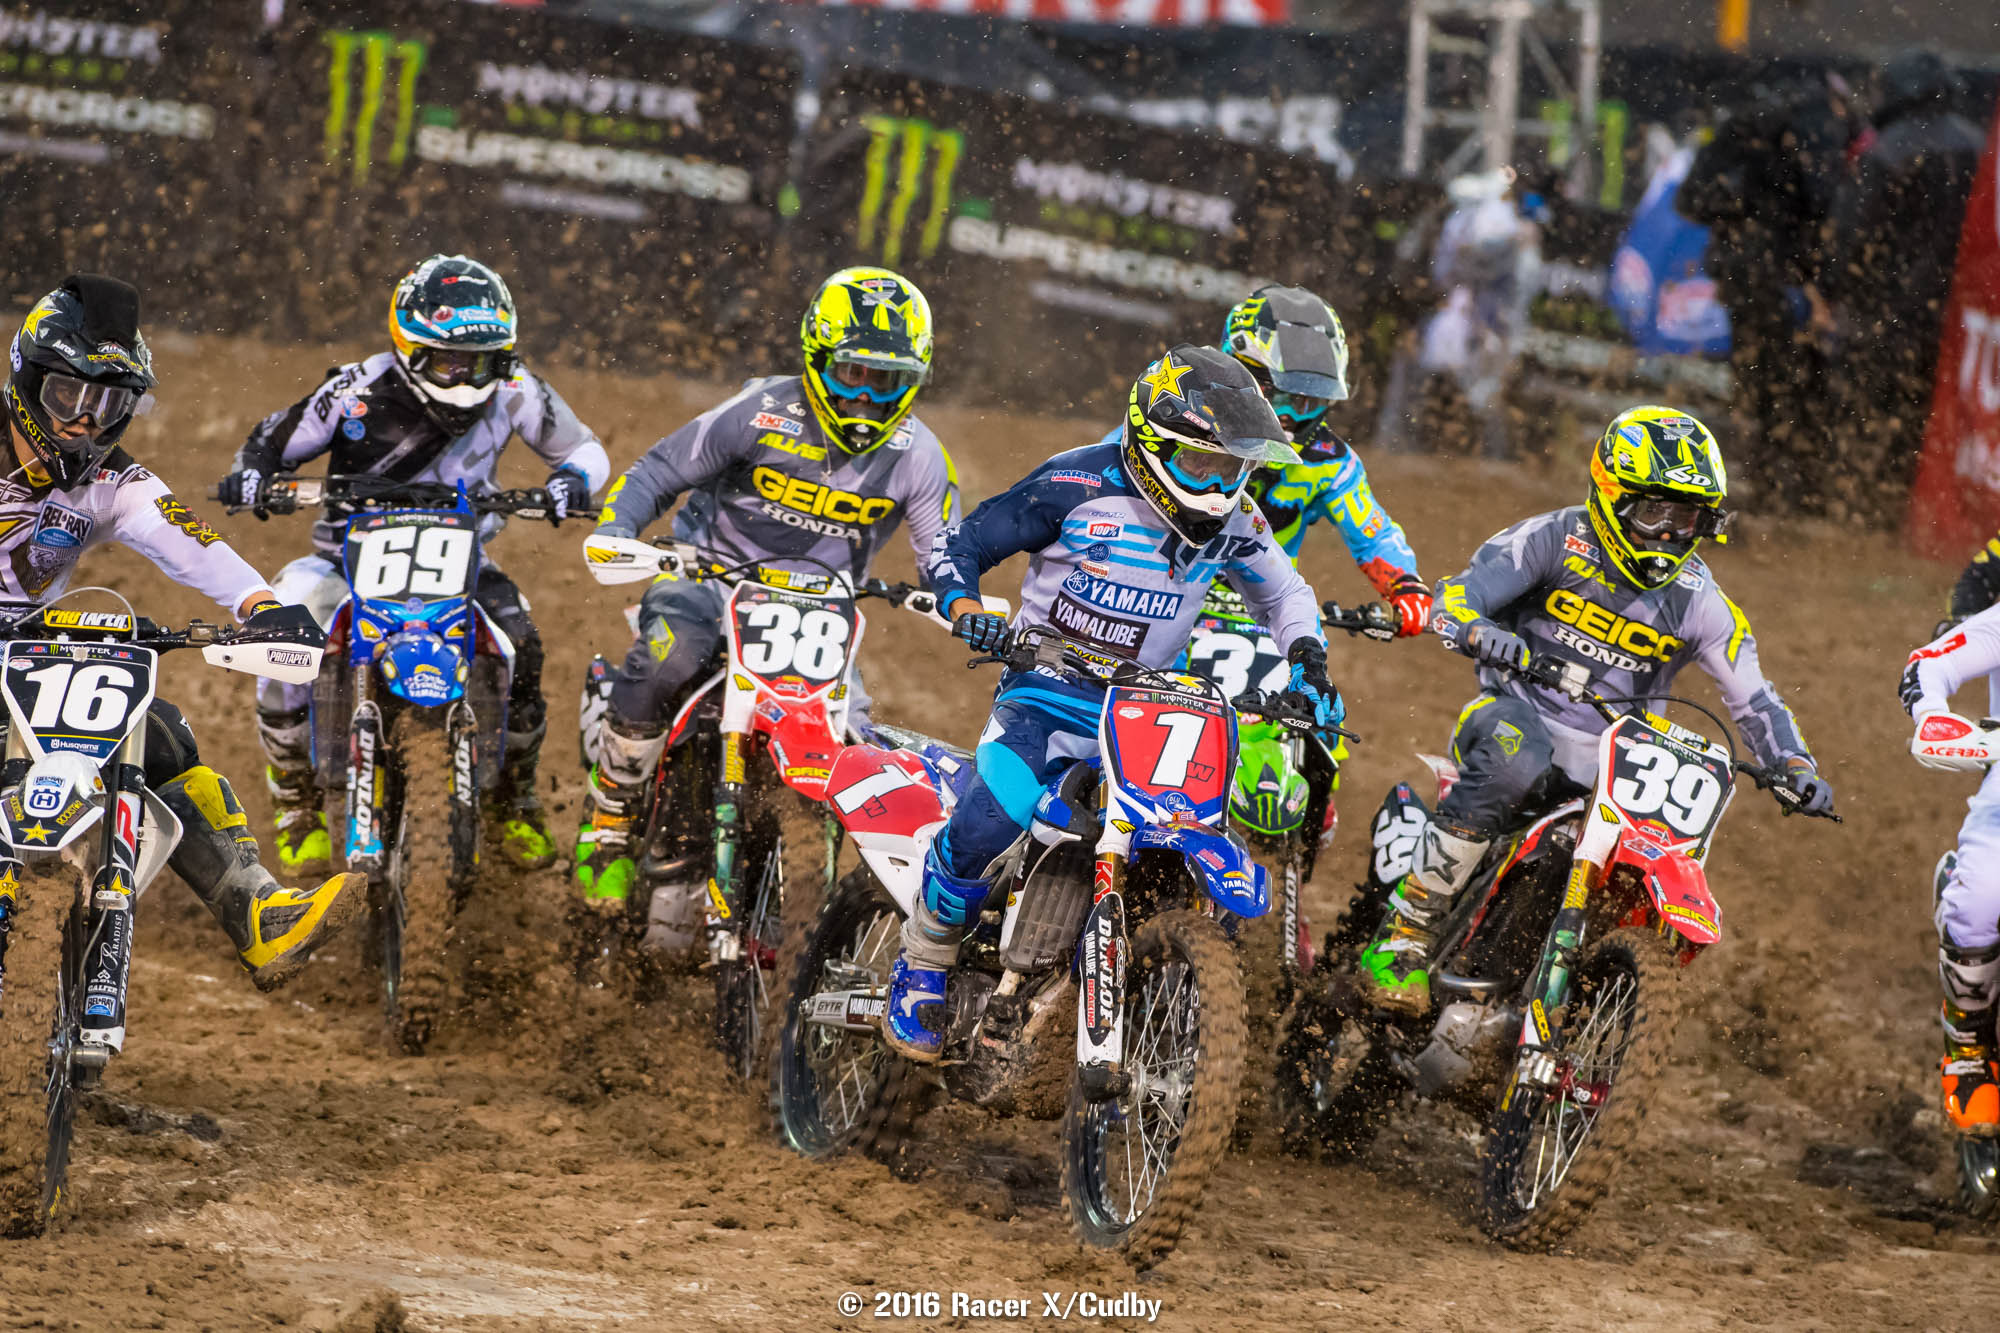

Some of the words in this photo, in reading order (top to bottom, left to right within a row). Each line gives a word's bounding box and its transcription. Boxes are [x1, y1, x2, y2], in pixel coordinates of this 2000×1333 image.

[752, 465, 897, 525] GEICO
[1664, 465, 1713, 487] 6D
[761, 503, 862, 540] HONDA
[1092, 525, 1119, 537] 100%
[353, 525, 475, 598] 69
[1090, 579, 1178, 618] YAMAHA
[742, 602, 850, 680] 38
[1056, 597, 1140, 648] YAMALUBE
[268, 649, 311, 667] PROTAPER
[1552, 625, 1654, 674] HONDA
[25, 663, 135, 732] 16
[1160, 694, 1205, 710] MONSTER
[59, 740, 100, 751] Husqvarna
[1148, 711, 1209, 789] 1
[1921, 745, 1989, 759] ACERBIS
[832, 764, 916, 816] 1
[1612, 742, 1722, 836] 39
[1663, 903, 1719, 934] GEICO
[1669, 913, 1716, 939] HONDA
[1084, 930, 1096, 977] YAMALUBE
[1099, 916, 1115, 1026] DUNLOP
[818, 1001, 842, 1011] GYTR
[849, 997, 885, 1016] YAMALUBE
[1087, 979, 1095, 1028] BRAKING
[1532, 999, 1551, 1041] GEICO
